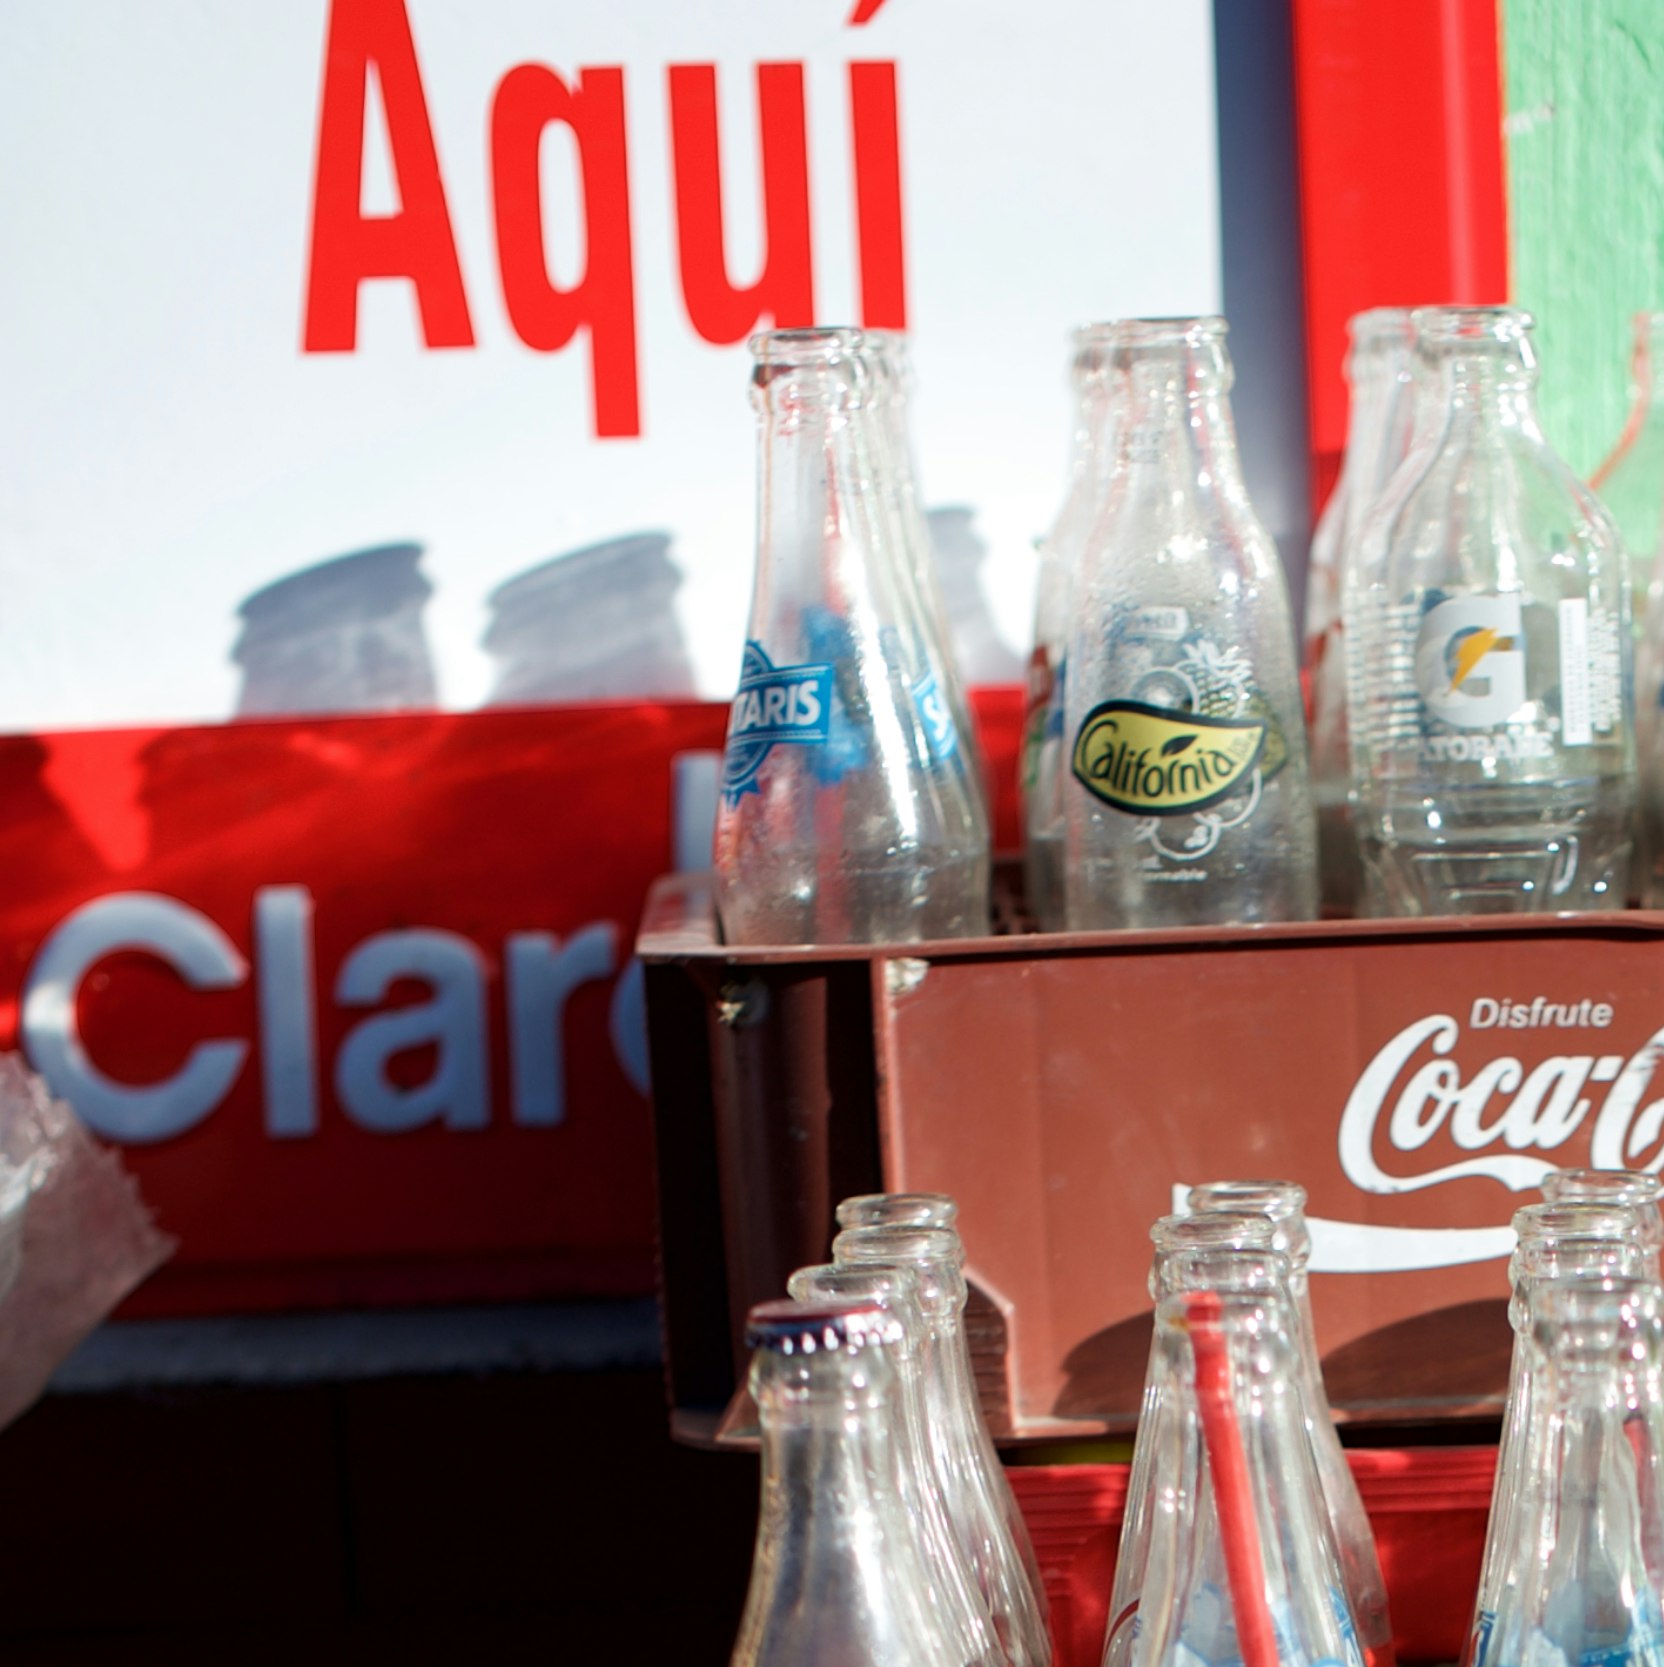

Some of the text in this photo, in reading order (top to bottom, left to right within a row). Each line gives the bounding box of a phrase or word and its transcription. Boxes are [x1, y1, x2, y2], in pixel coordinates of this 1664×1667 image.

[301, 0, 908, 440] Aquí
[733, 680, 821, 732] TARIS
[1081, 719, 1237, 798] California
[21, 884, 650, 1146] Clar
[1470, 996, 1614, 1031] Disfrute
